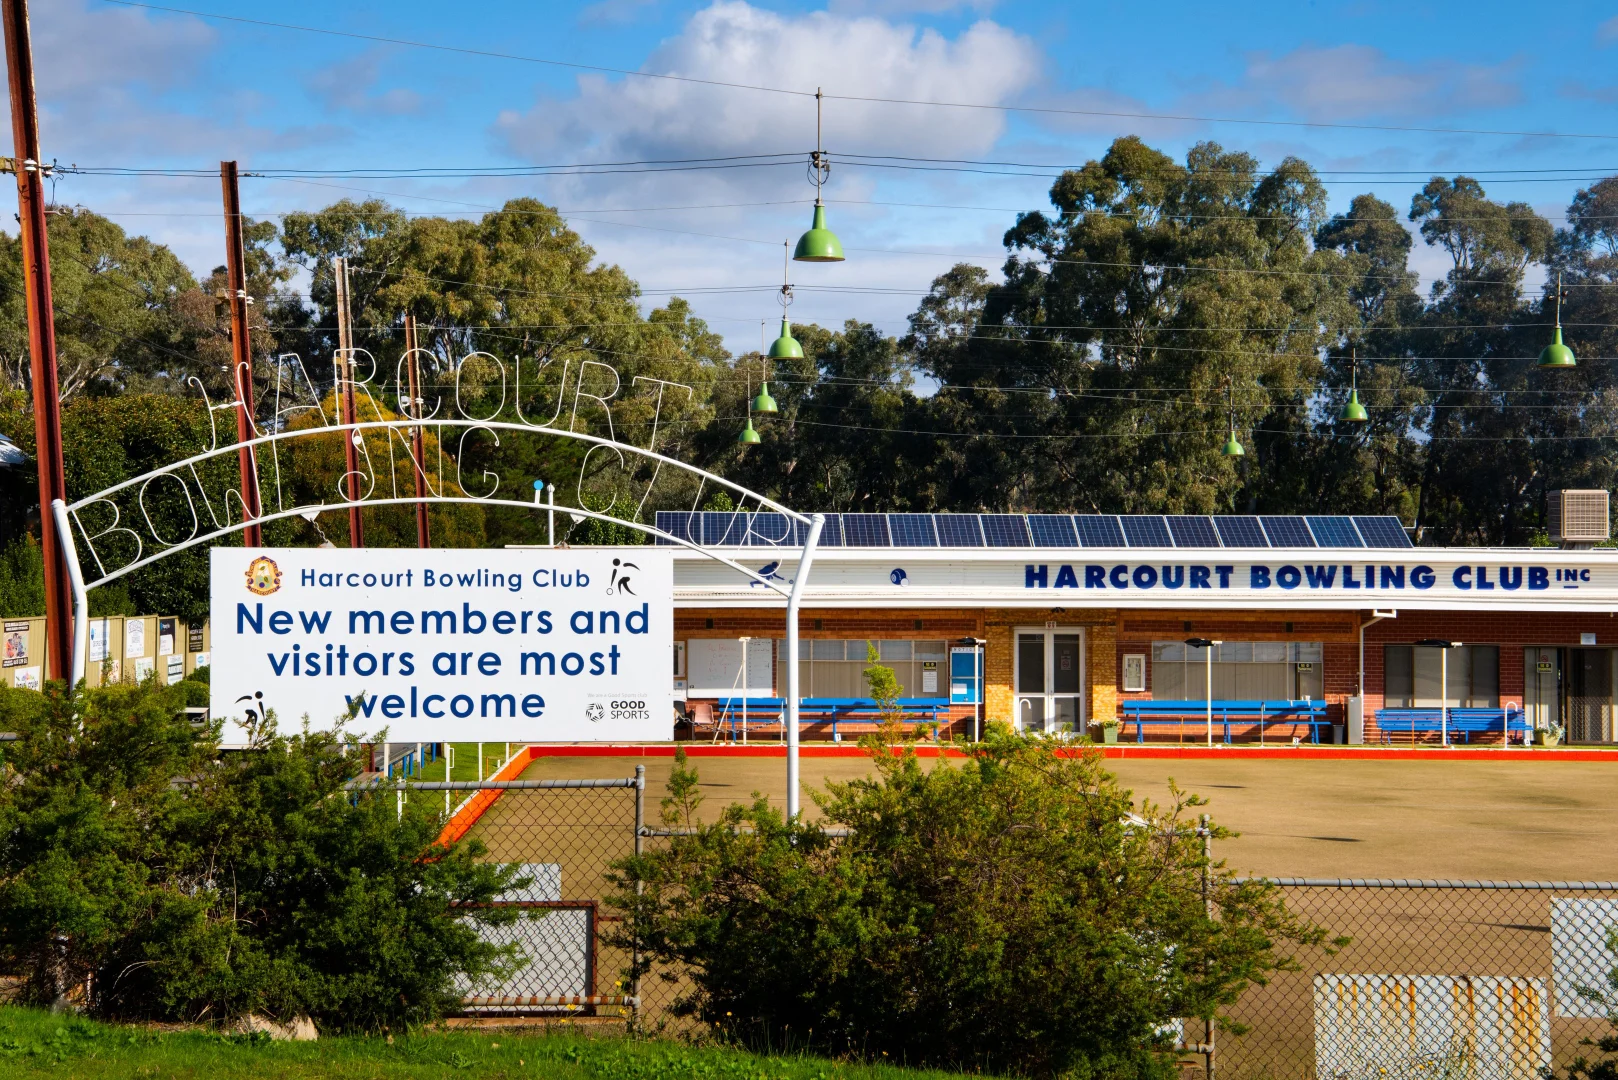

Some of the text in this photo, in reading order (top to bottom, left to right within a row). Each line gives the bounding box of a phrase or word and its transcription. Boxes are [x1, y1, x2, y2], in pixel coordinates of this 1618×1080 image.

[188, 347, 693, 453] HARCOURT
[577, 443, 792, 577] CLUB
[301, 568, 590, 592] Harcourt Bowling Club
[1024, 564, 1591, 590] HARCOURT BOWLING CLUB INC
[236, 602, 649, 635] New members and
[266, 643, 621, 677] visitors are most
[344, 685, 546, 719] welcome
[610, 700, 646, 709] GOOD
[610, 710, 650, 720] SPORTS
